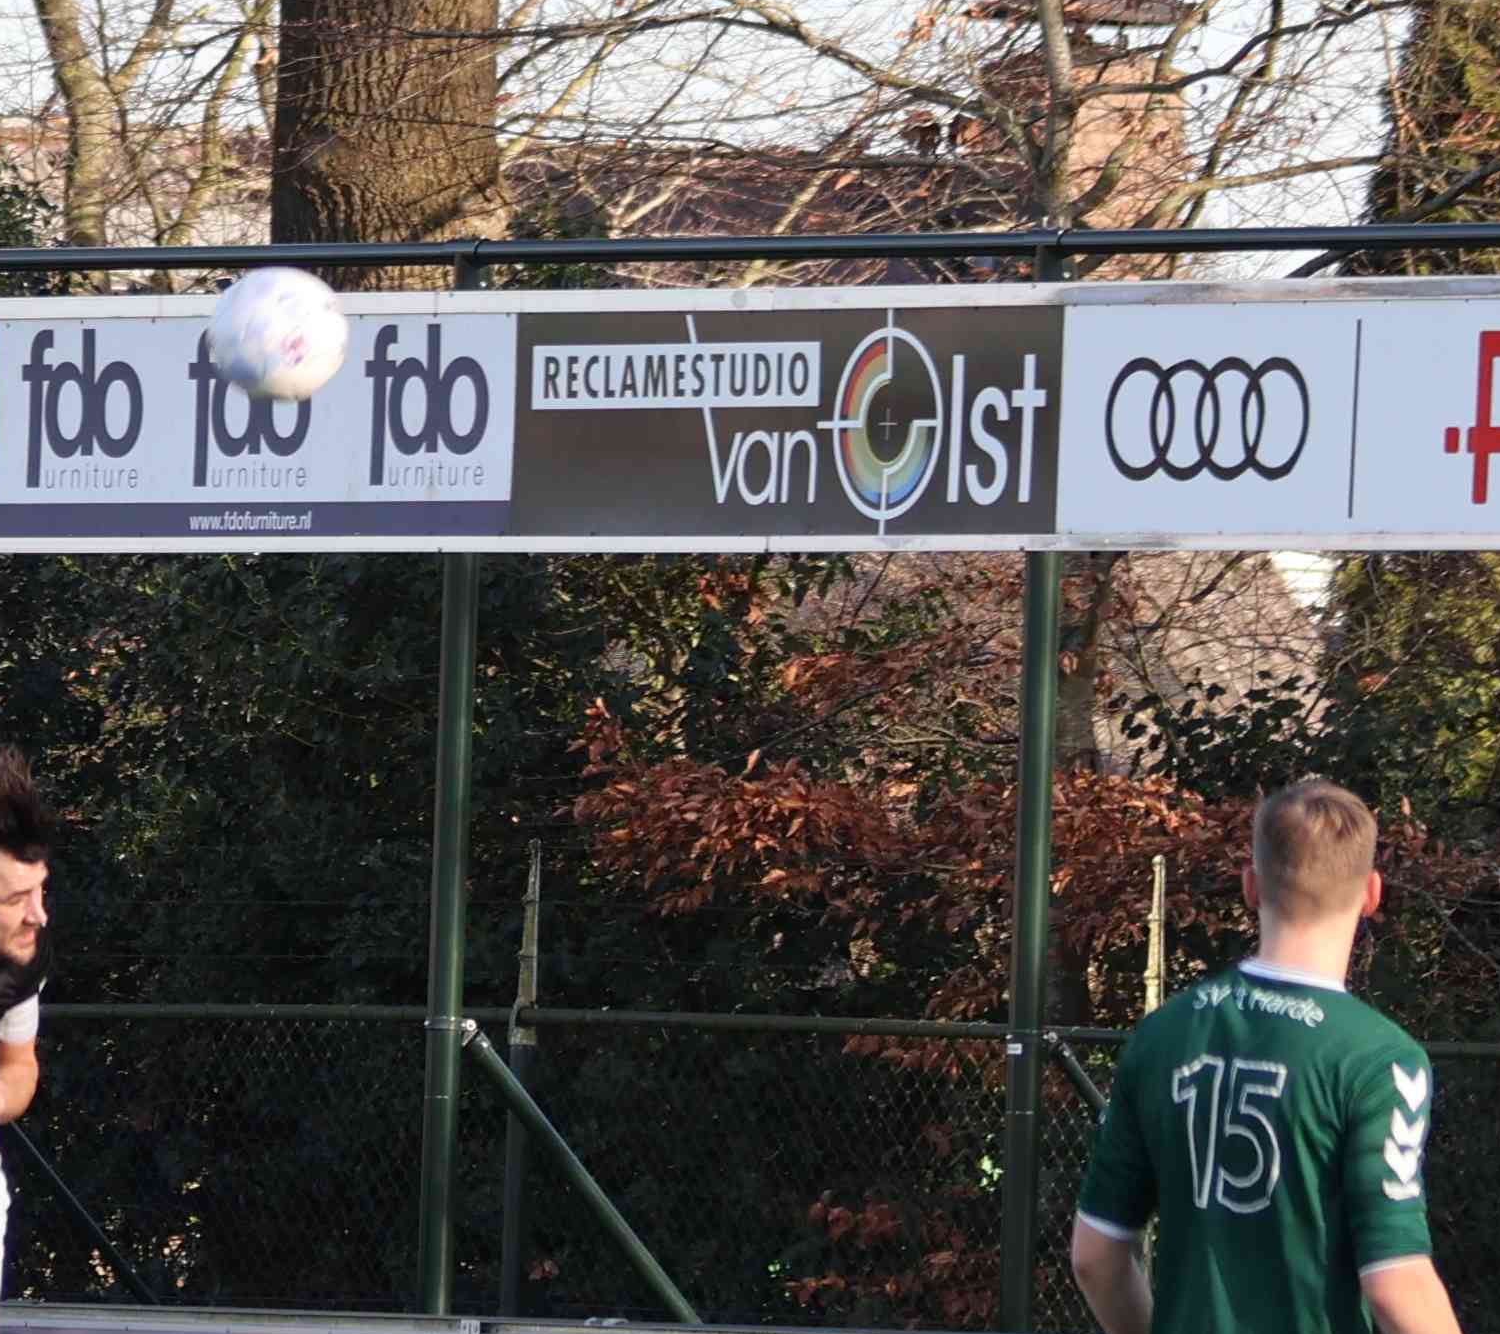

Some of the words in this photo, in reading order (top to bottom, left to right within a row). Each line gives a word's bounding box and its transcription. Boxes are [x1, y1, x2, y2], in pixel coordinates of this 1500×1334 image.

[22, 328, 144, 490] fdo
[365, 323, 490, 487] fdo
[542, 351, 811, 400] RECLAMESTUDIO
[189, 510, 312, 532] www.fdofurniture.nl
[702, 427, 818, 505] van
[1171, 1053, 1288, 1214] 15
